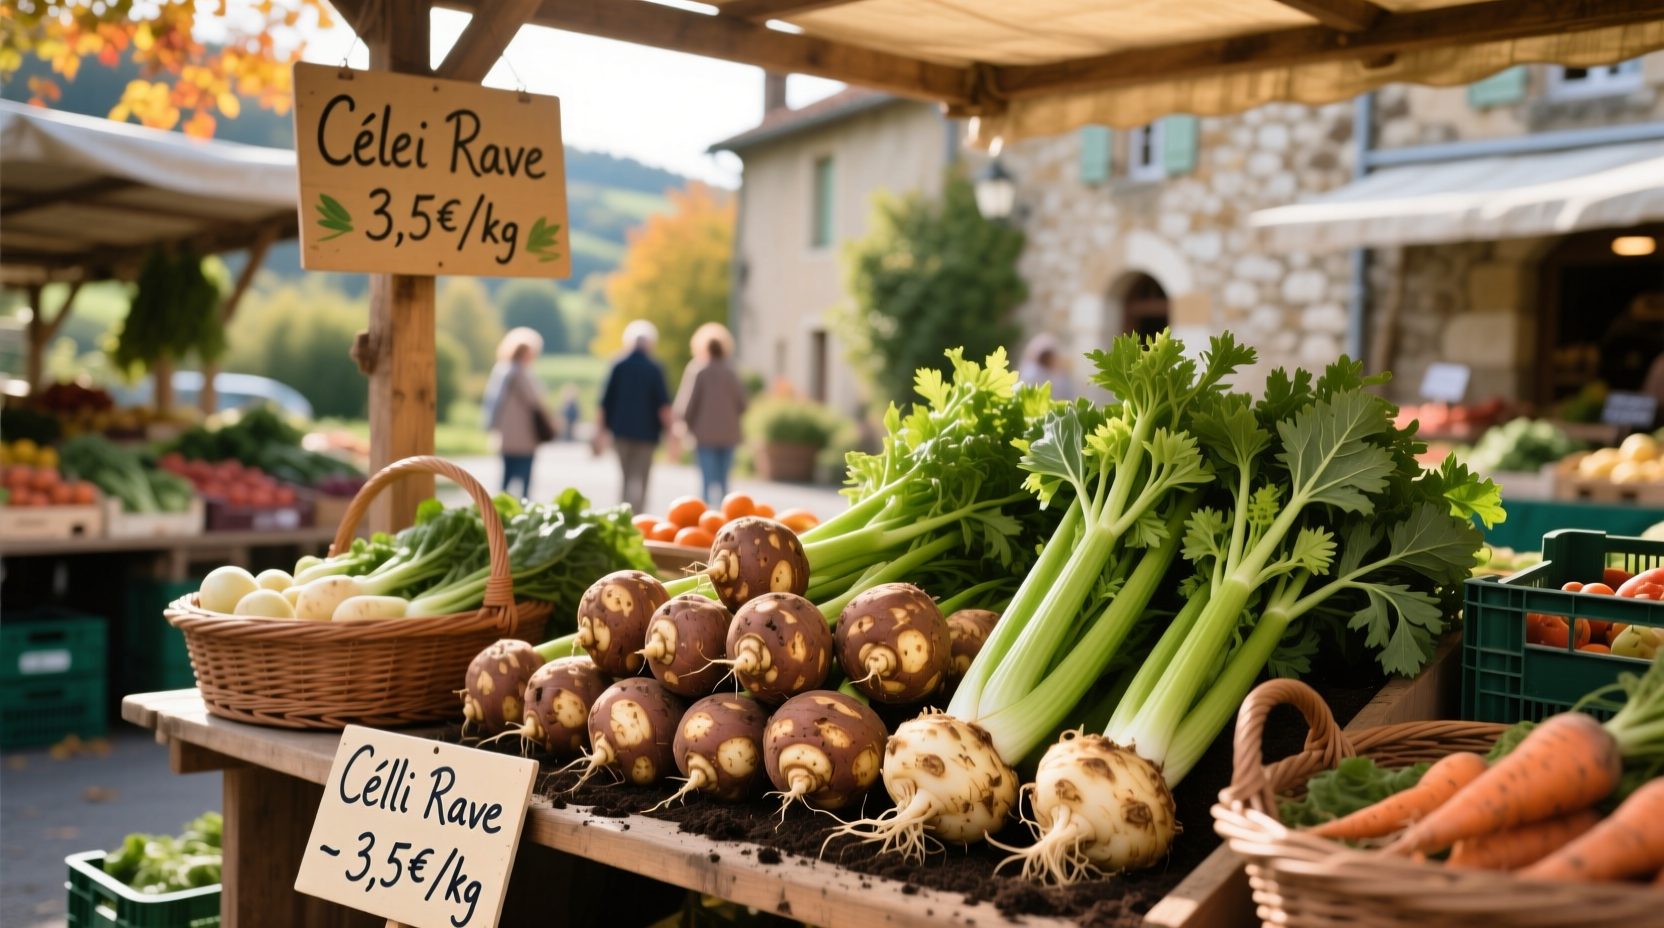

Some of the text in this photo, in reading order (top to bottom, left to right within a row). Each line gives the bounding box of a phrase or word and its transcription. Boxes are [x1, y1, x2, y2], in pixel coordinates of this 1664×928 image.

[317, 94, 546, 179] Célei Rave
[365, 187, 519, 265] 3,5€/kg
[340, 744, 503, 834] Célli Rave
